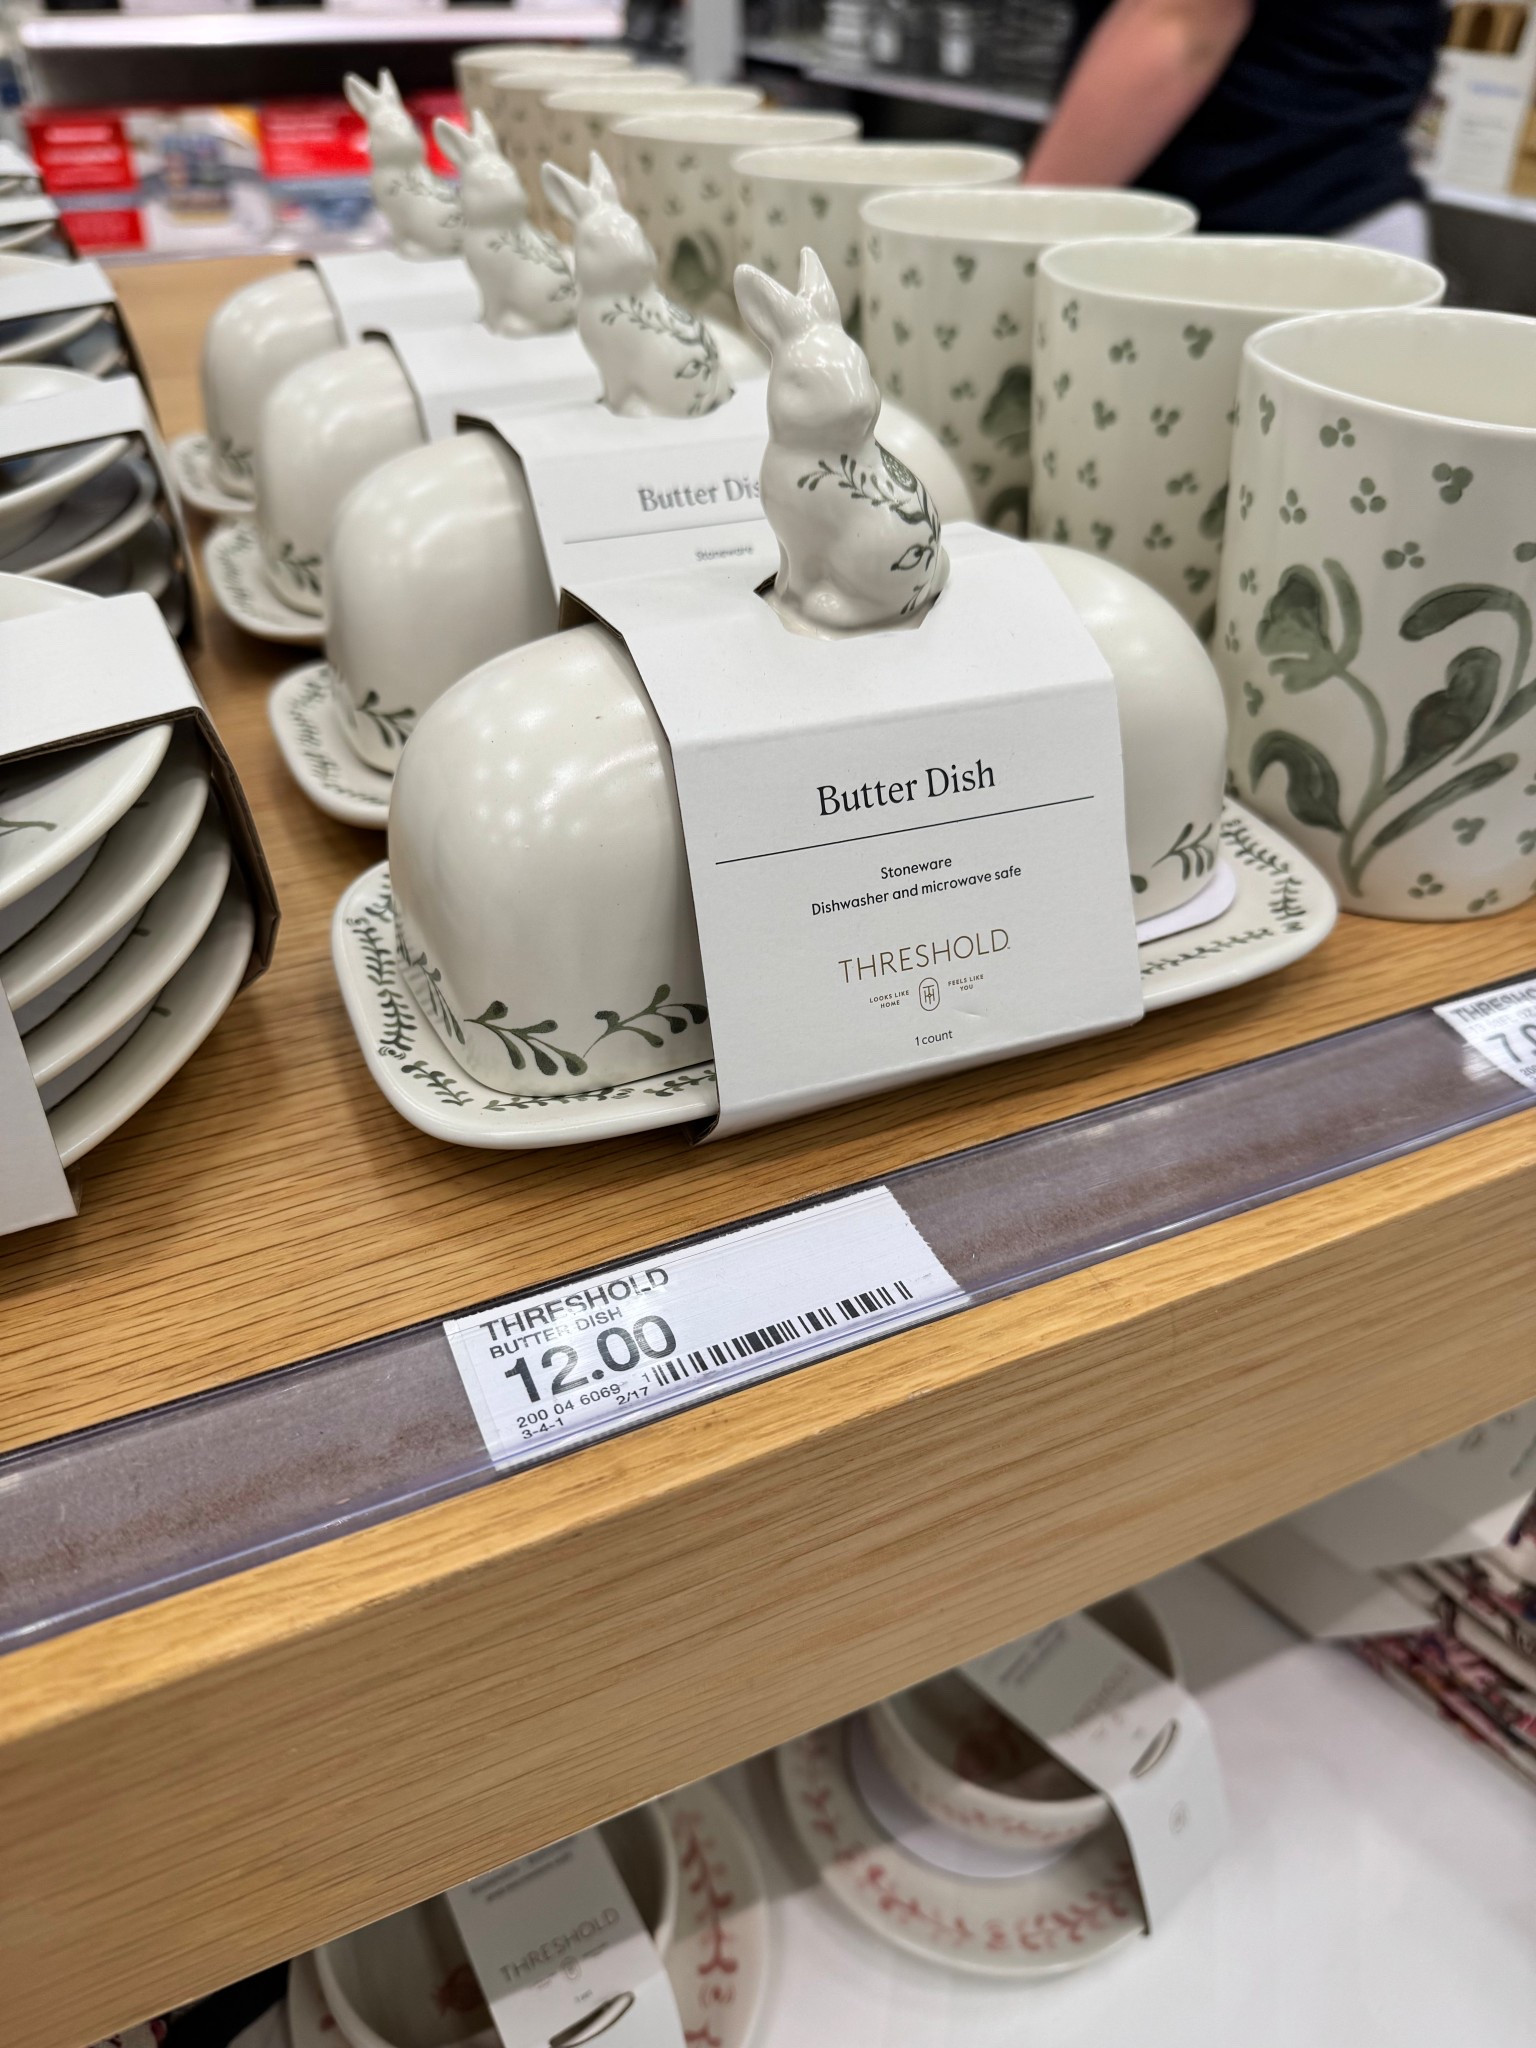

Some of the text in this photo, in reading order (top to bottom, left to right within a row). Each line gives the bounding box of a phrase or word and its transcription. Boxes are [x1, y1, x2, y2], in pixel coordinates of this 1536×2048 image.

[638, 475, 760, 512] Butter Dis
[816, 759, 996, 816] Butter Dish
[880, 857, 952, 880] Stoneware
[811, 865, 1022, 916] Dishwasher and microwave safe
[838, 928, 1010, 983] THRESHOLD
[947, 973, 984, 987] FEELS LIKE
[959, 984, 974, 992] YOU
[869, 989, 910, 1004] LOOKS LIKE
[880, 999, 901, 1009] HOME
[914, 1029, 953, 1047] 1 count
[479, 1267, 669, 1342] THRESHOLD
[489, 1306, 623, 1359] BUTTER DISH
[504, 1314, 677, 1404] 12.00
[516, 1383, 621, 1429] 200 04 6069
[616, 1386, 648, 1406] 2/17
[521, 1417, 564, 1440] 3-4-1
